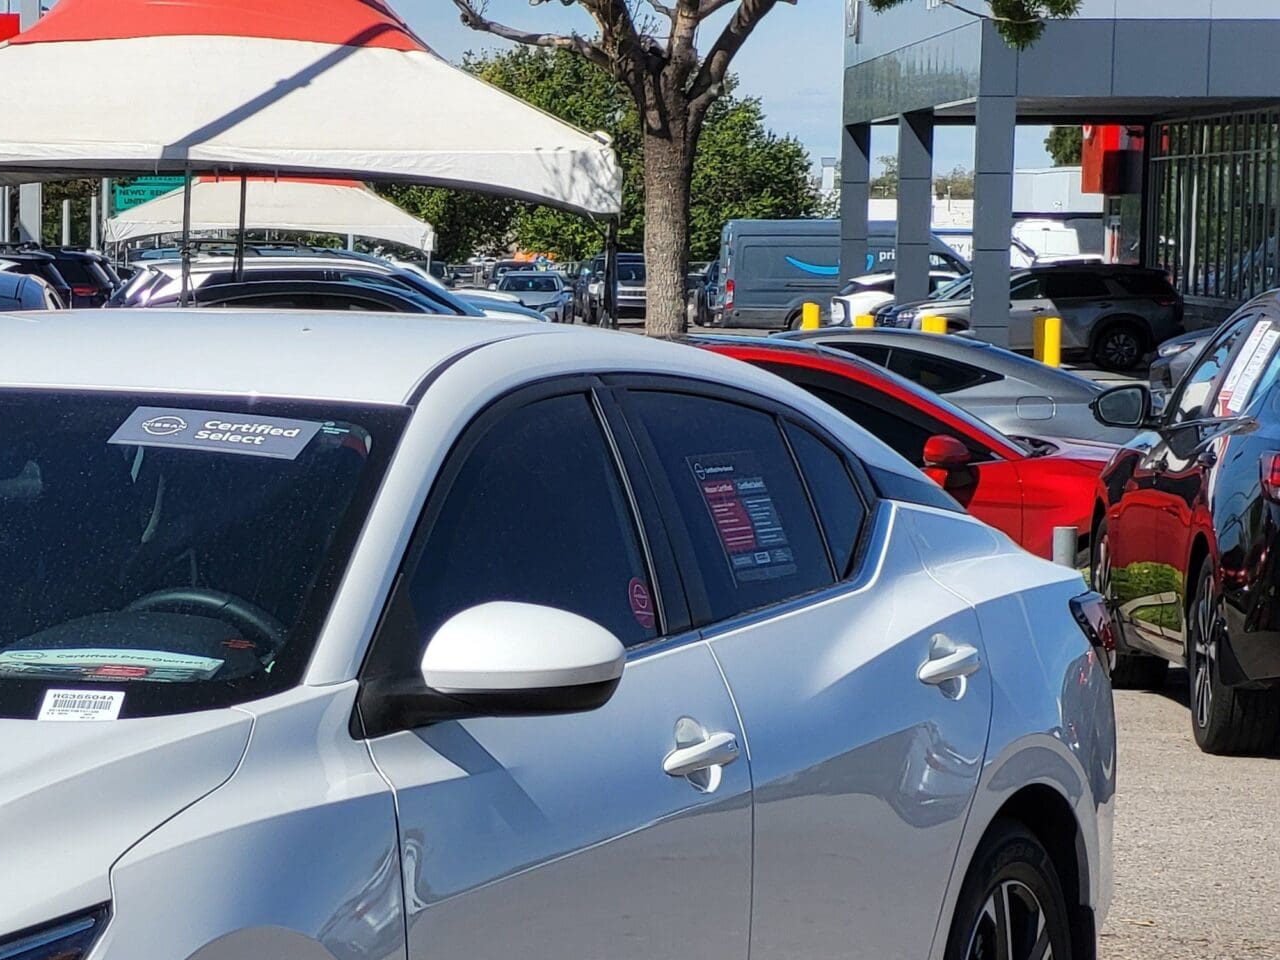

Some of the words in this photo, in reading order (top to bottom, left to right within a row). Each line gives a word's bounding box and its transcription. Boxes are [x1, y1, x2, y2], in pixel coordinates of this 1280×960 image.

[879, 249, 895, 261] pri
[141, 421, 188, 431] NISSAN
[203, 420, 301, 438] Certified
[194, 430, 266, 445] Select
[121, 655, 204, 664] Pre-Owned
